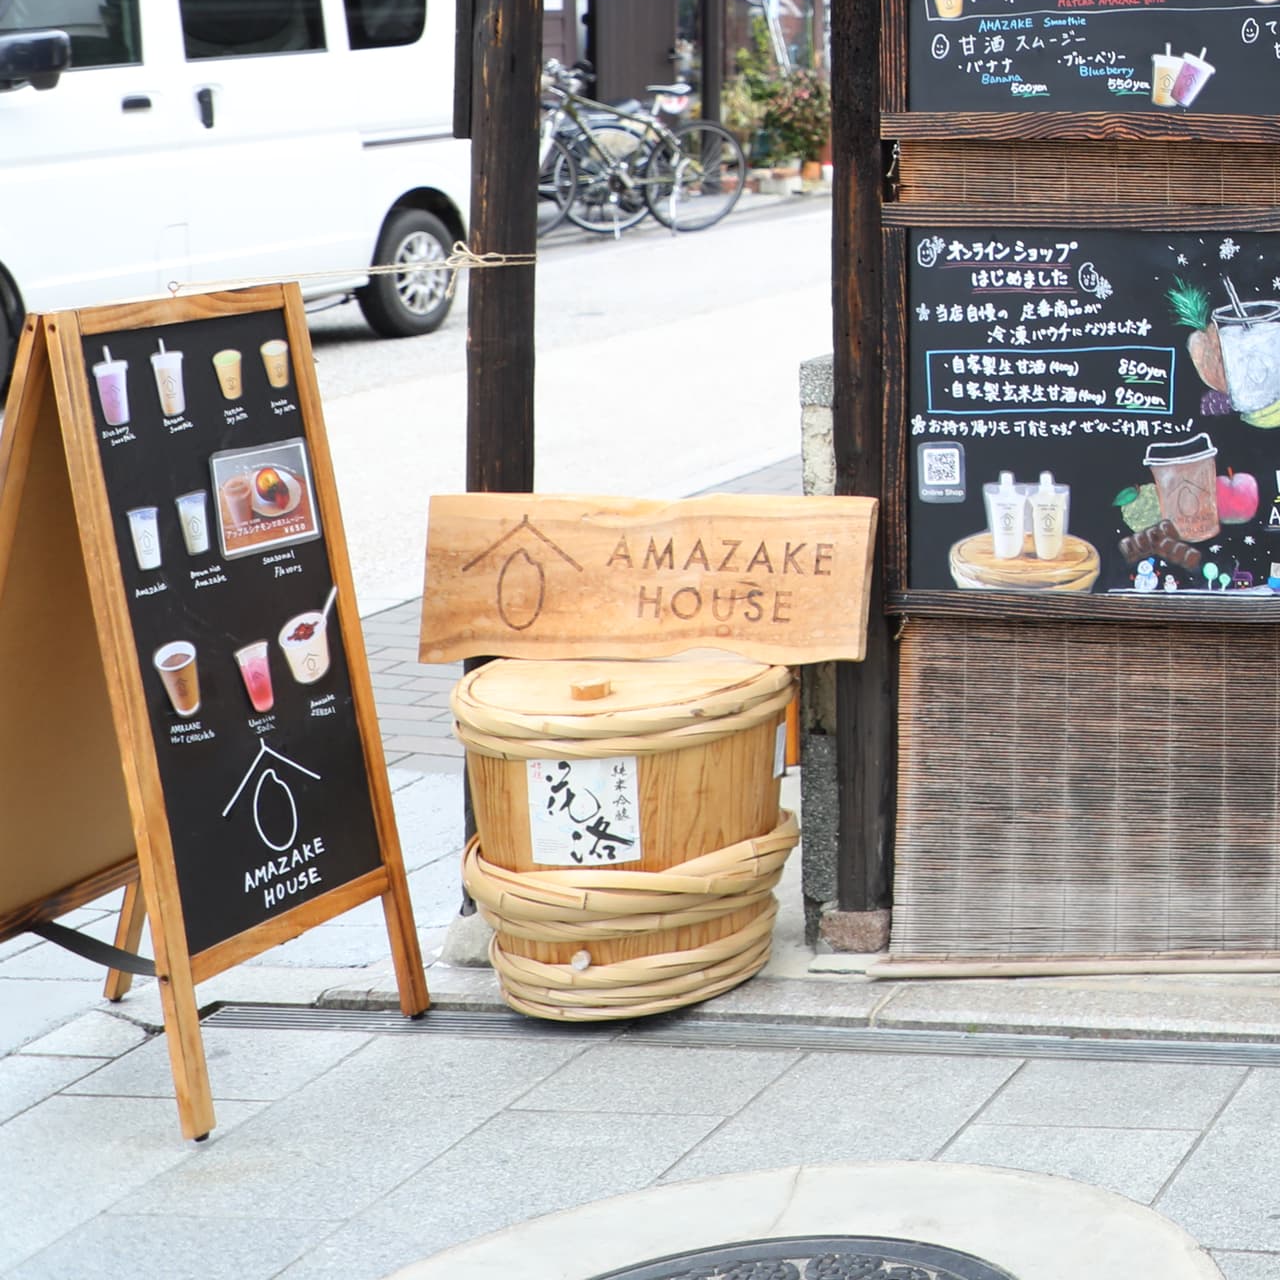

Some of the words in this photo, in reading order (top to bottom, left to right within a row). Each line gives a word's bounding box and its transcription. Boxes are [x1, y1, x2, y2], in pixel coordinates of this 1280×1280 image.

[979, 19, 1033, 32] AMAZAKE
[958, 30, 1086, 56] 甘酒スムージー
[966, 58, 1013, 74] バナナ
[1063, 51, 1126, 67] ブルーベリー
[981, 73, 1023, 85] Banana
[1079, 65, 1135, 78] Blueberry
[946, 241, 1078, 263] オンラインショップ
[971, 270, 1068, 288] はじめました
[1118, 358, 1167, 379] 850yen
[1115, 387, 1166, 407] 950yen
[945, 488, 965, 498] Shop
[606, 534, 835, 577] AMAZAKE
[636, 583, 795, 623] HOUSE
[244, 836, 326, 893] AMAZAKE
[263, 866, 322, 910] HOUSE
